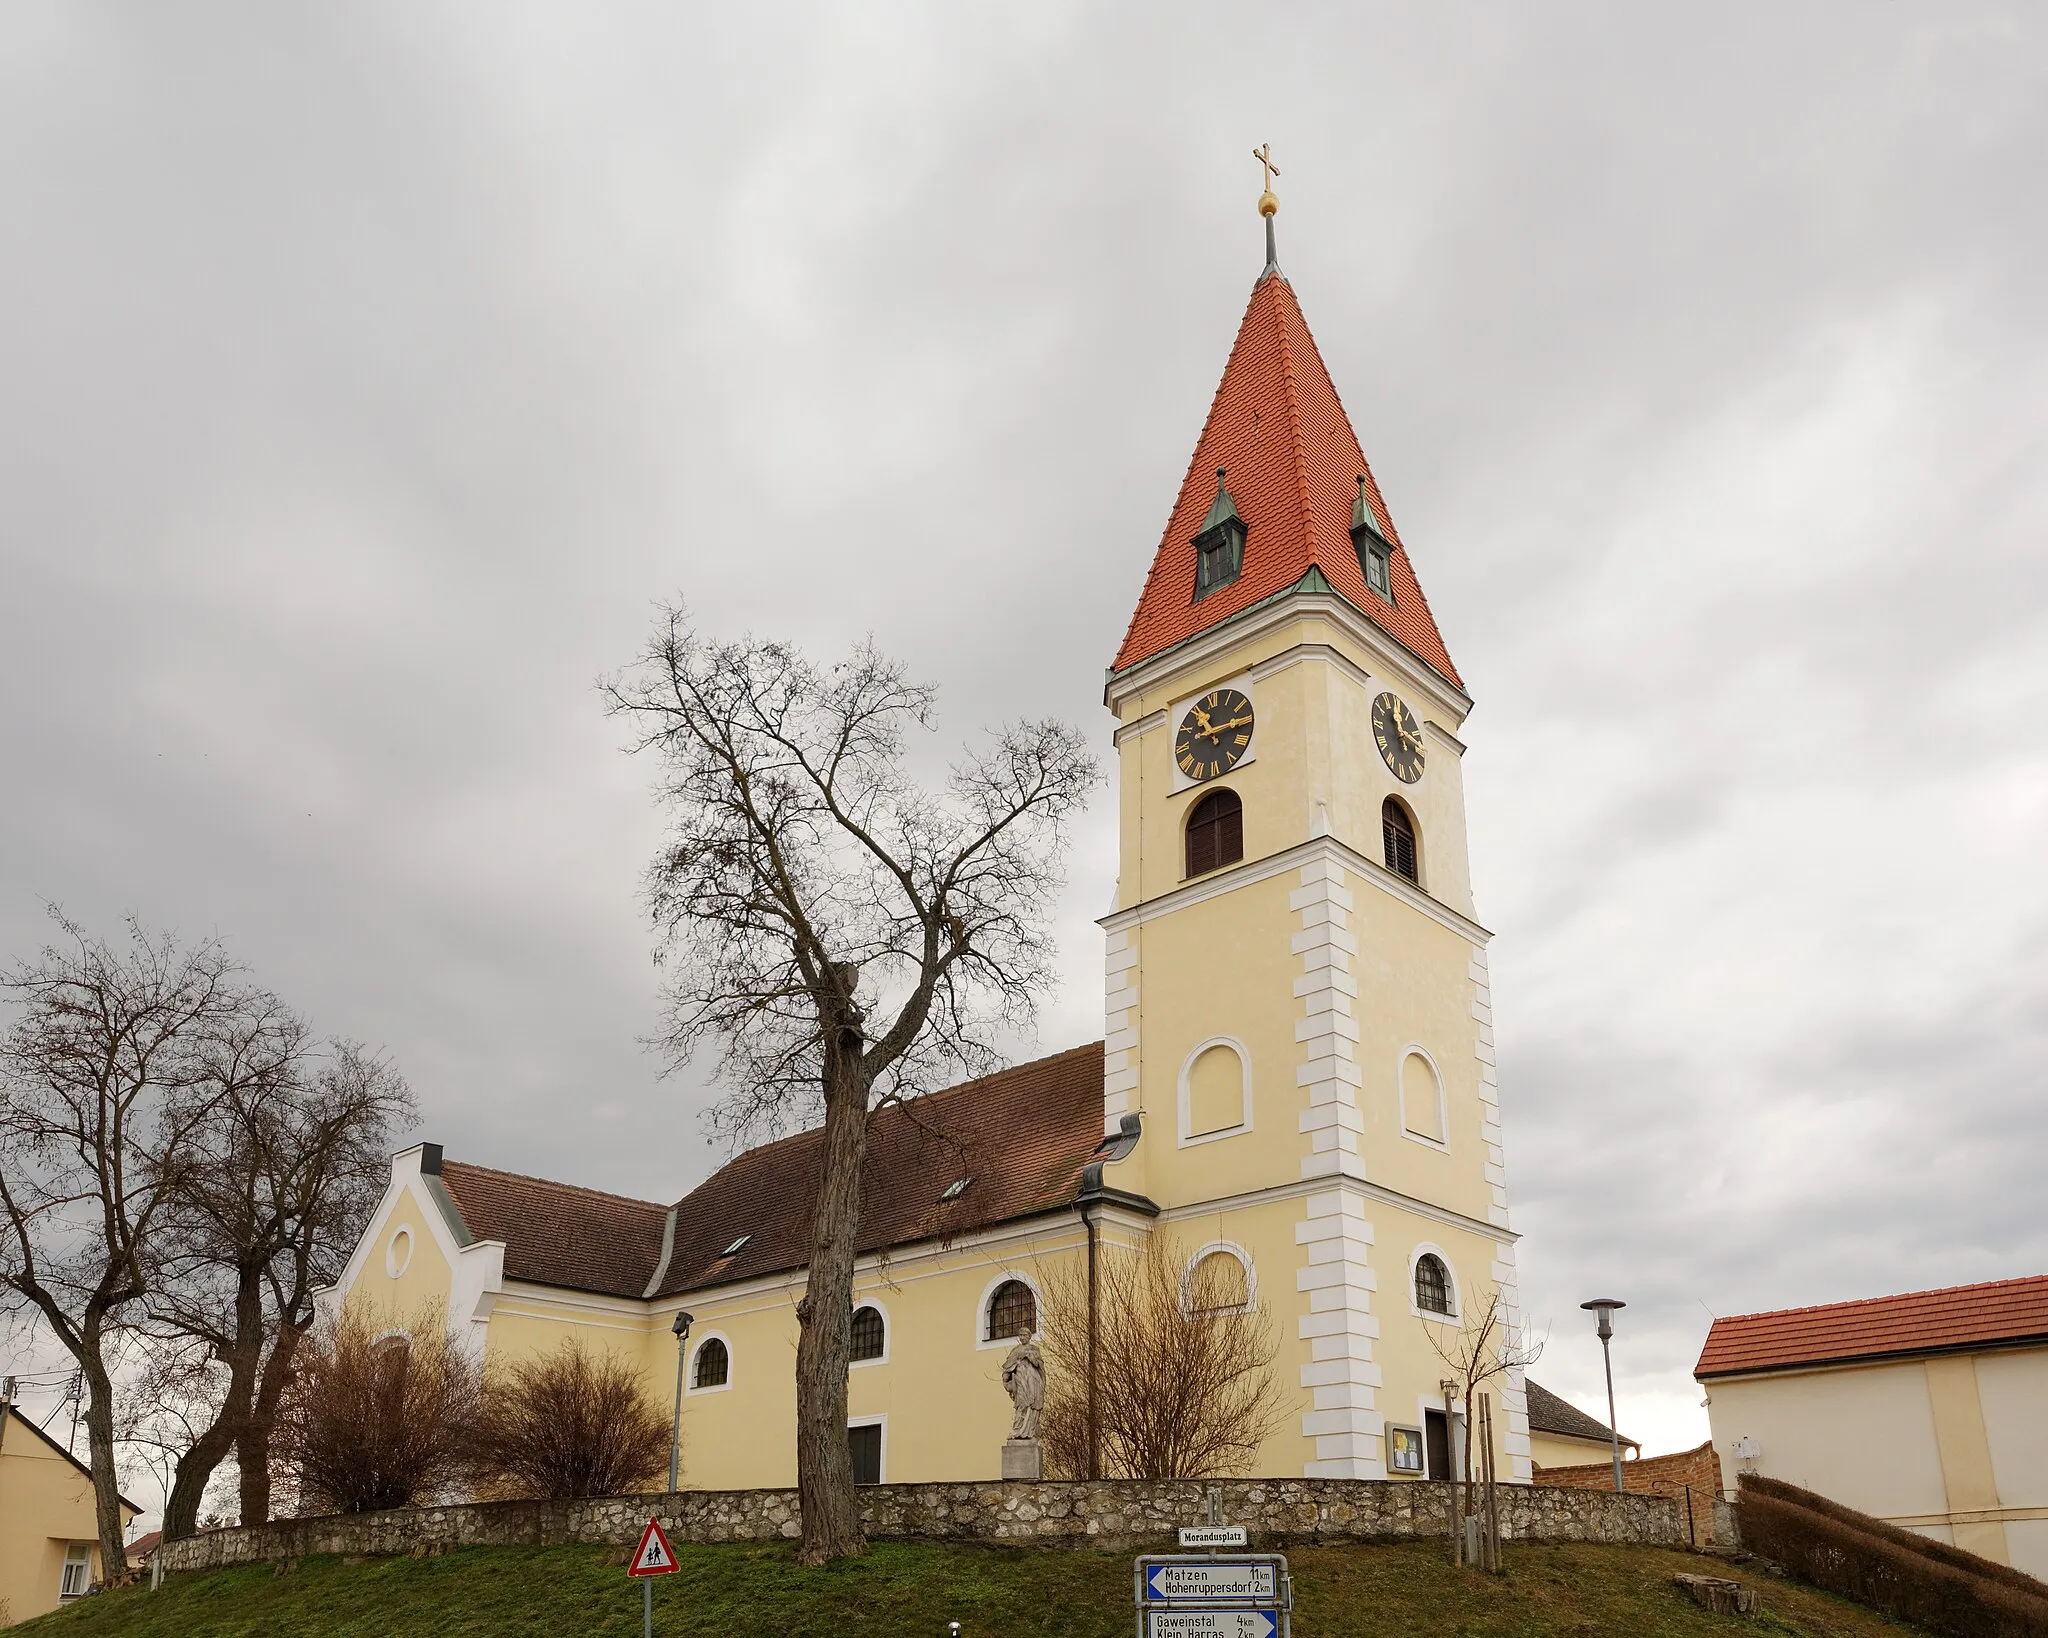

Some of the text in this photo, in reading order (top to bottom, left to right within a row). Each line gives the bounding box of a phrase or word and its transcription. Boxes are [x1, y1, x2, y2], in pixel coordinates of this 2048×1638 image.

[1184, 1532, 1242, 1543] Morandusplatz
[1165, 1569, 1208, 1581] Matzen
[1165, 1581, 1252, 1595] Hohenruppersdorf
[1157, 1615, 1215, 1627] Gaweinstal
[1157, 1628, 1182, 1638] Klein
[1188, 1628, 1224, 1638] Harras
